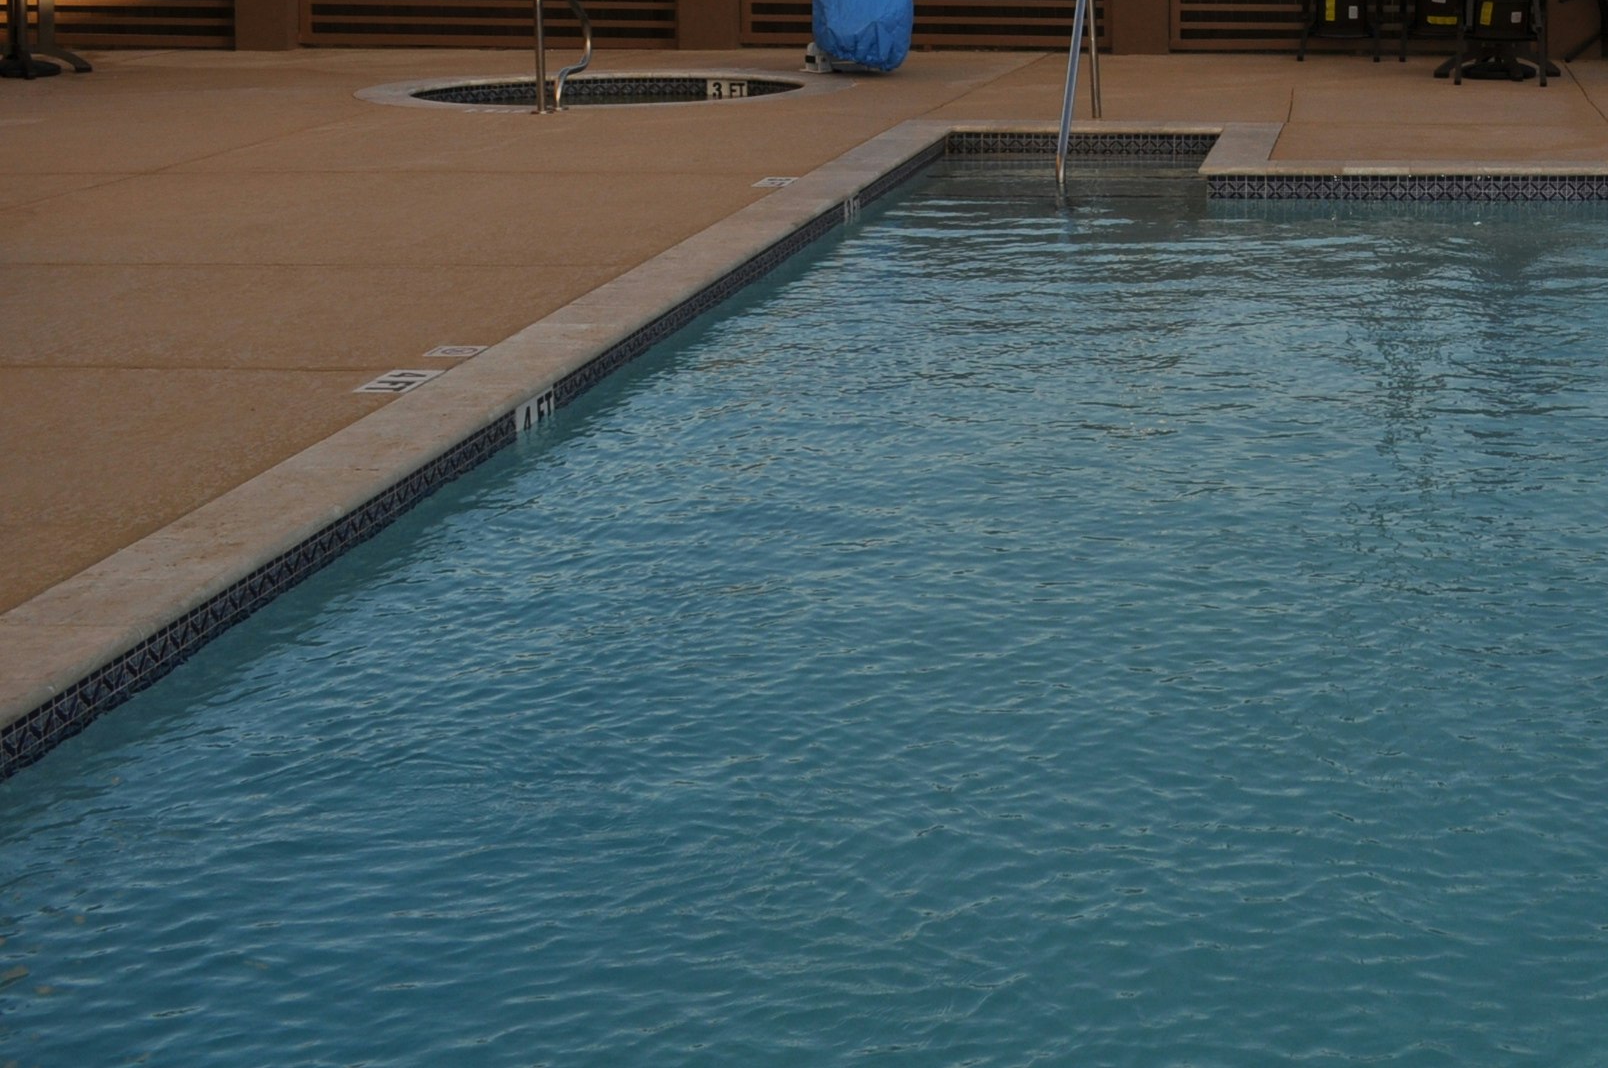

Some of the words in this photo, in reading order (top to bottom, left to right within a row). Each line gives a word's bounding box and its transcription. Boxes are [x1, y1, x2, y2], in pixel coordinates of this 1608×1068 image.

[712, 81, 722, 100] 3
[730, 82, 745, 98] FT
[364, 380, 416, 392] FT
[523, 406, 532, 431] 4
[537, 391, 554, 423] FT
